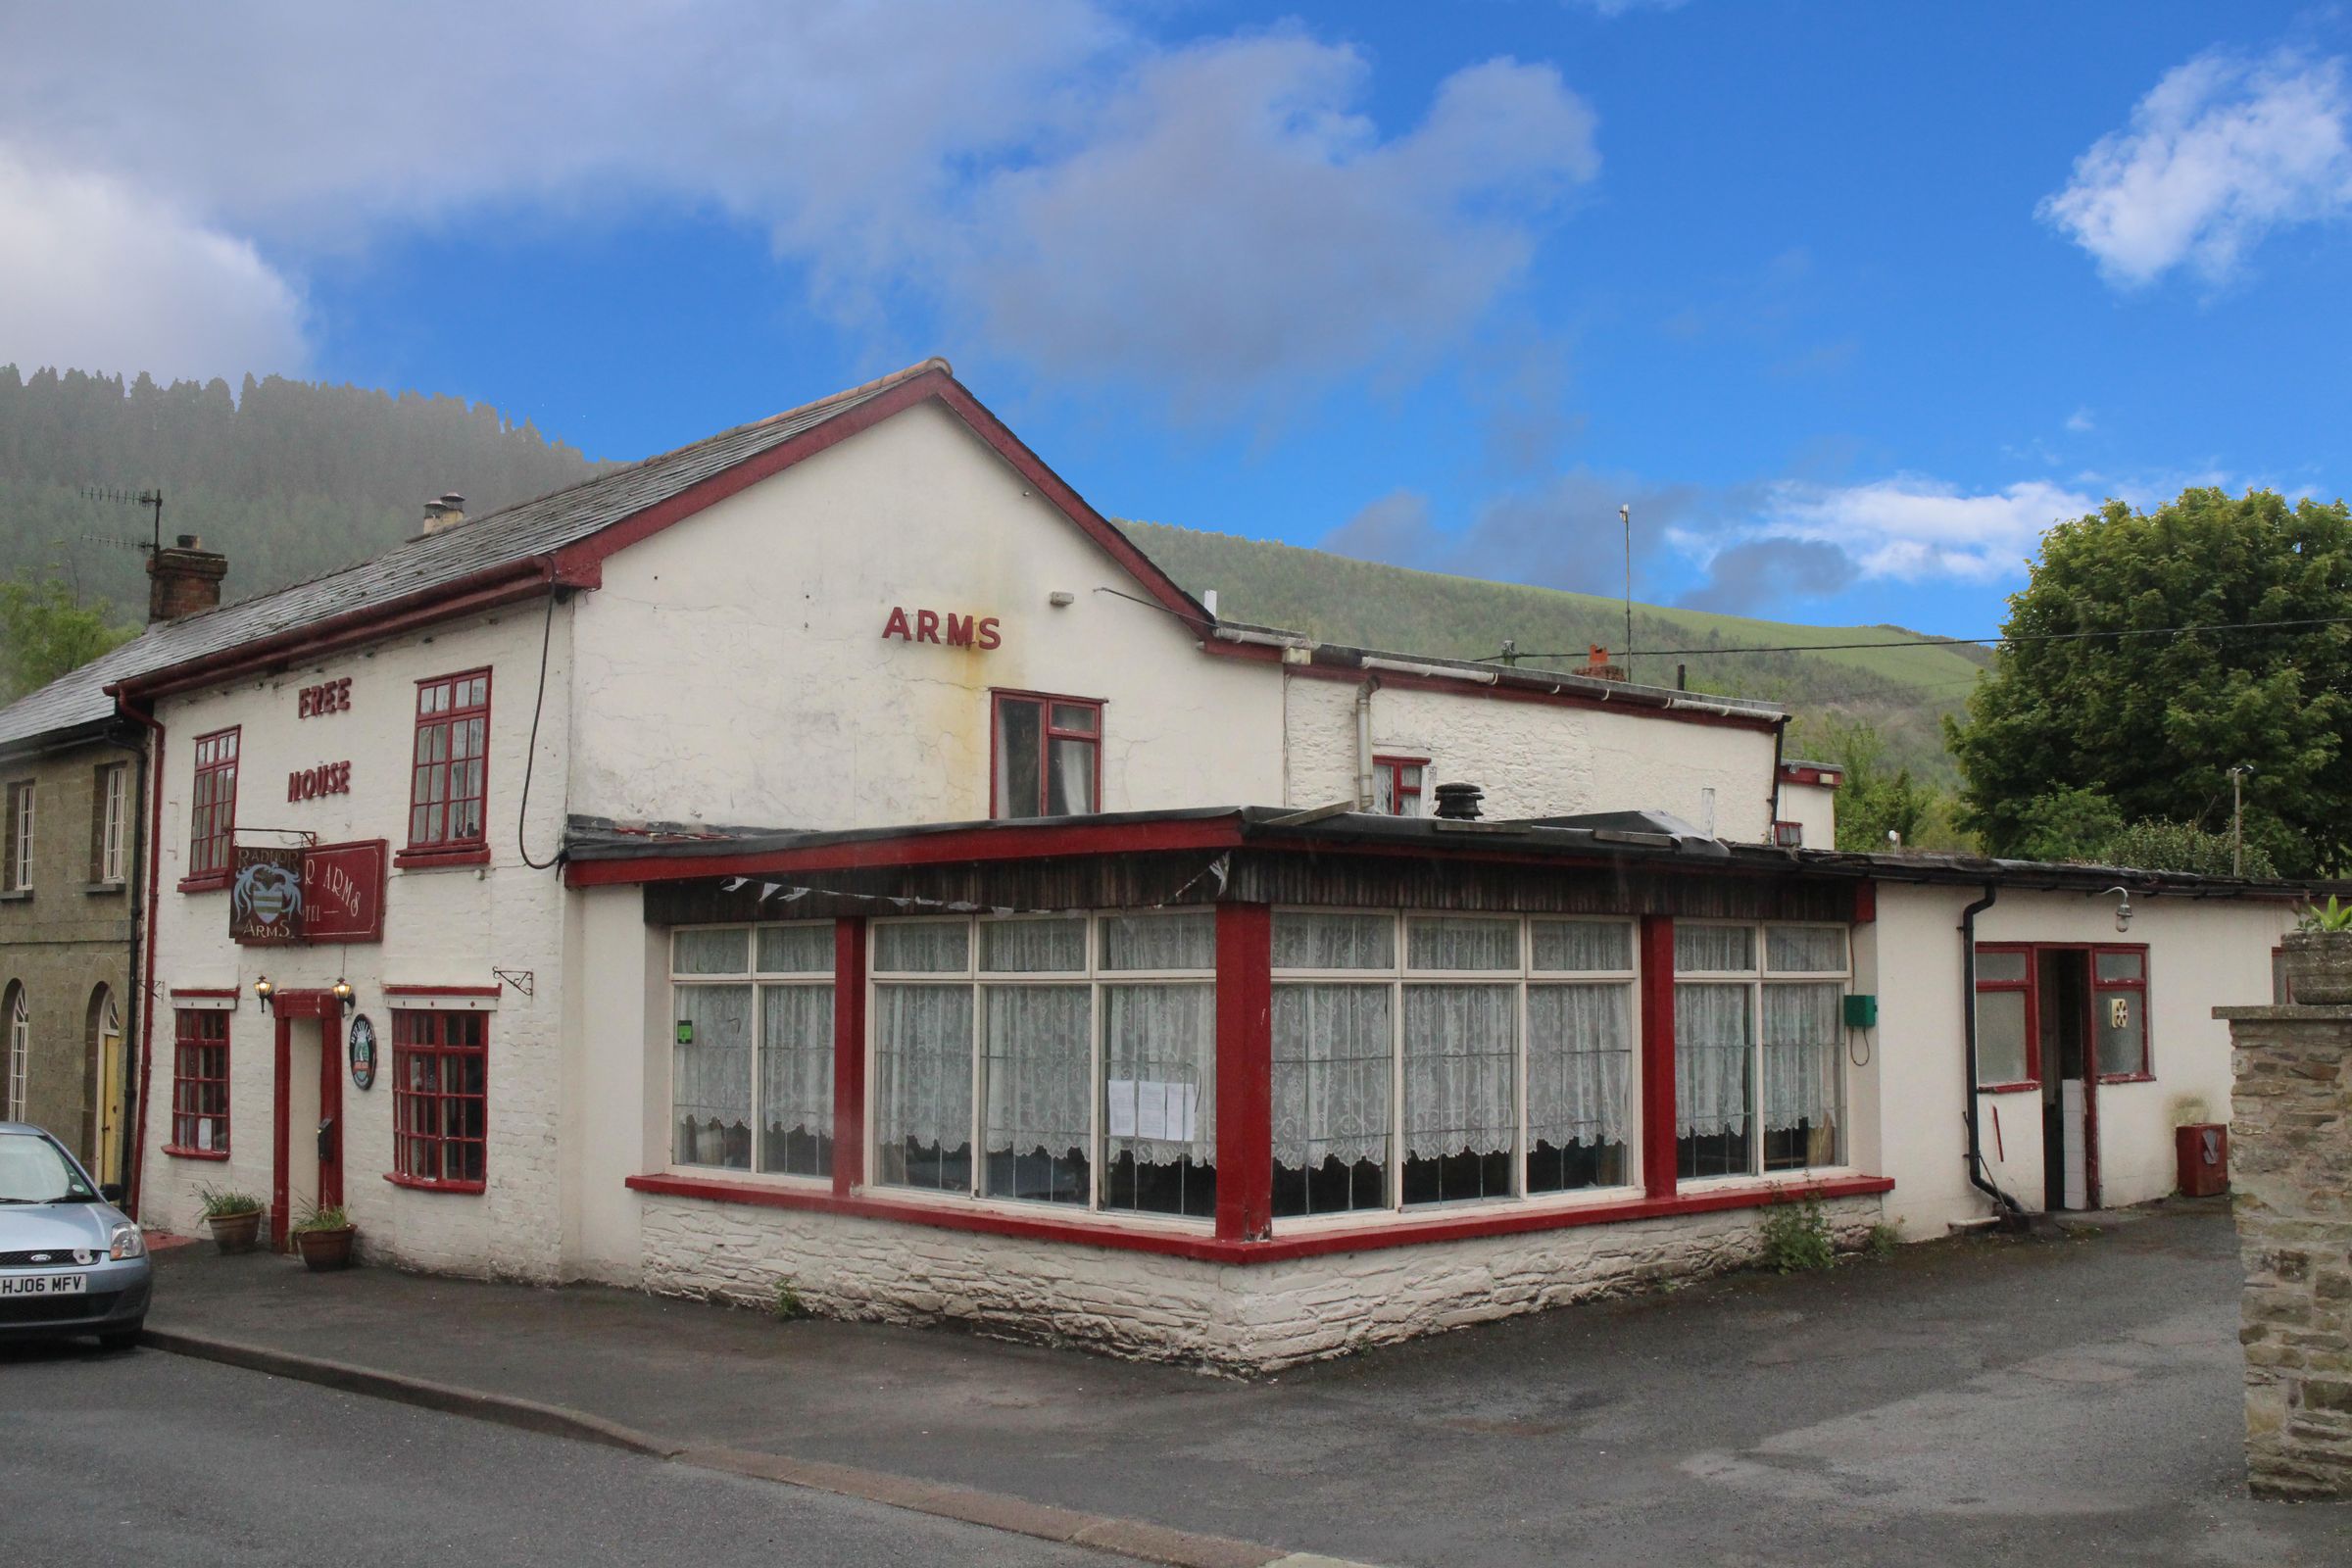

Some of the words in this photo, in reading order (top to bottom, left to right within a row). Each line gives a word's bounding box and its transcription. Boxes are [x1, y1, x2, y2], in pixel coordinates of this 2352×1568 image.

[881, 606, 1002, 650] ARMS
[298, 677, 352, 719] FREE
[287, 760, 352, 803] HOUSE
[322, 862, 362, 918] ARMS
[243, 918, 291, 939] ARMS
[2, 1277, 46, 1295] HJ06
[51, 1275, 82, 1293] MFV
